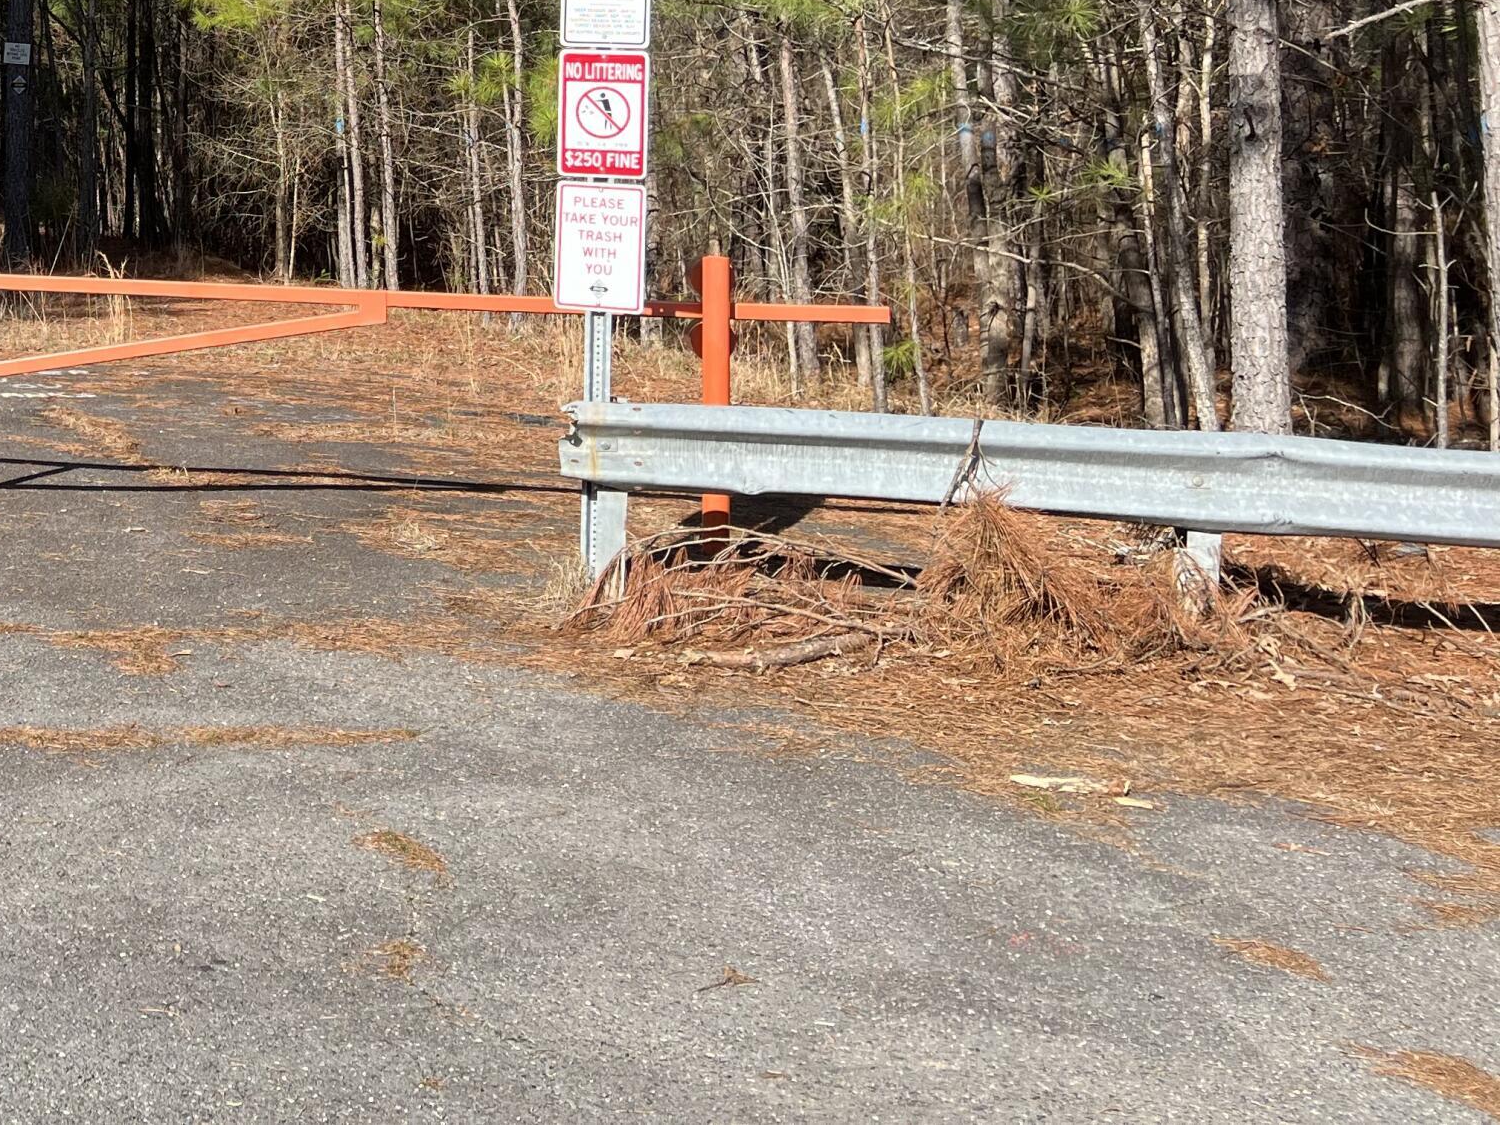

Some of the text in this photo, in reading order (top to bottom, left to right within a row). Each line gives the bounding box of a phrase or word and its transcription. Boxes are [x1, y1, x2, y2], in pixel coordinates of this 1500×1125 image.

[565, 62, 643, 81] NO LITTERING
[565, 150, 640, 169] $250 FINE
[573, 196, 625, 210] PLEASE
[562, 211, 638, 227] TAKE YOUR
[578, 229, 623, 243] TRASH
[583, 247, 617, 259] WITH
[586, 263, 613, 276] YOU
